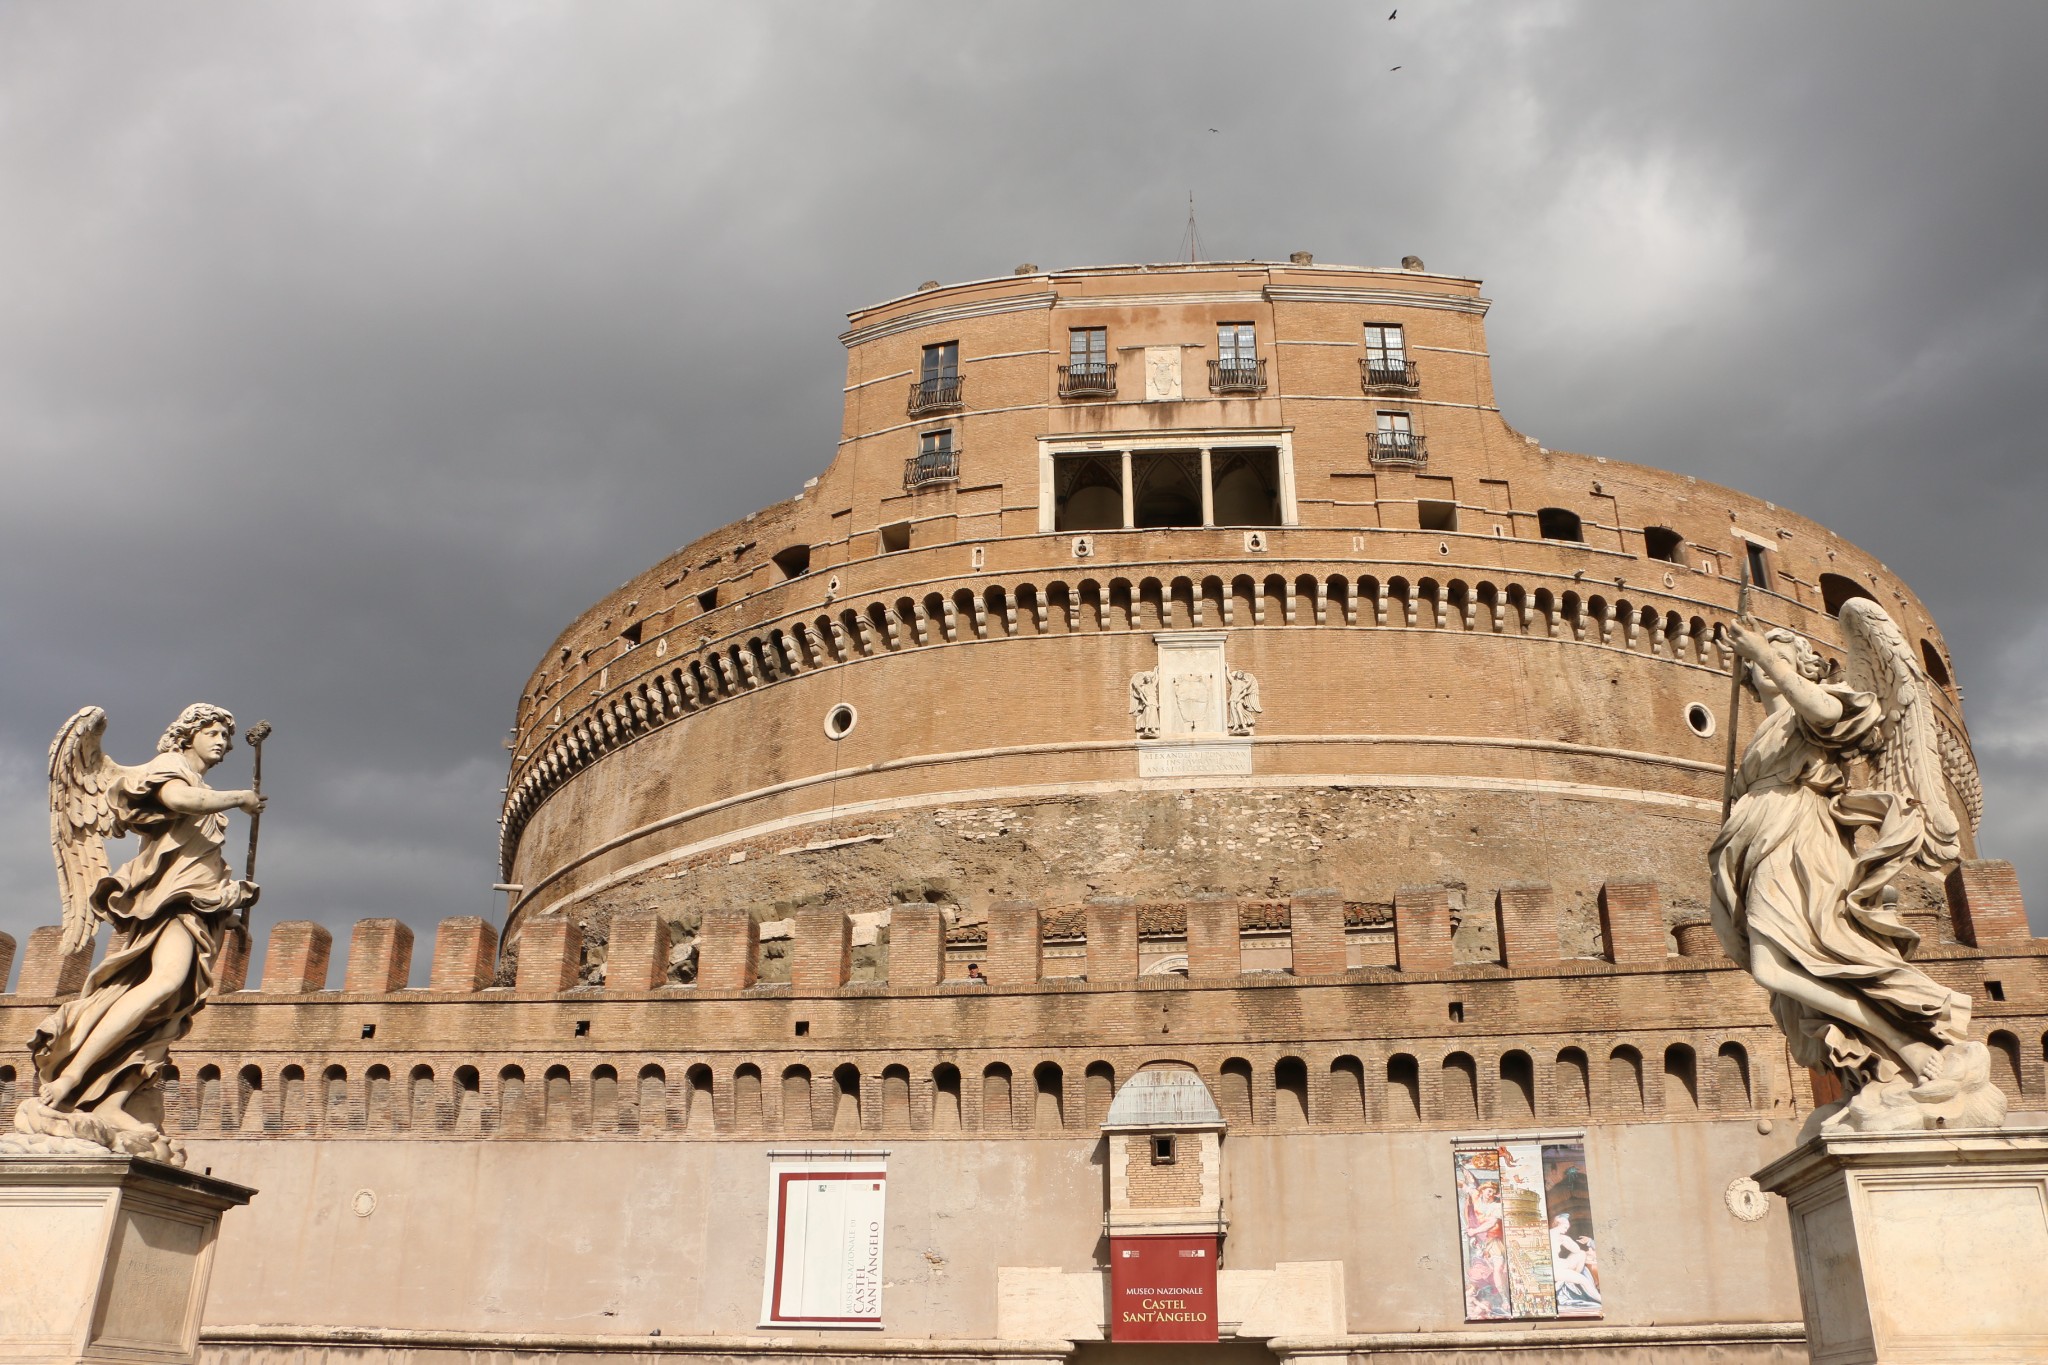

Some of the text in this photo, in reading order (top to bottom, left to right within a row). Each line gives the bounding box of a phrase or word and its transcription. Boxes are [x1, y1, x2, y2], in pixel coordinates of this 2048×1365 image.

[847, 1230, 856, 1280] NAZIONALE
[865, 1221, 879, 1314] SANT'ANGELO
[853, 1265, 866, 1314] CASTEL
[1126, 1287, 1204, 1295] MUSEO NAZIONALE
[1142, 1298, 1187, 1310] CASTEL
[1122, 1310, 1207, 1323] SANT'ANGELO
